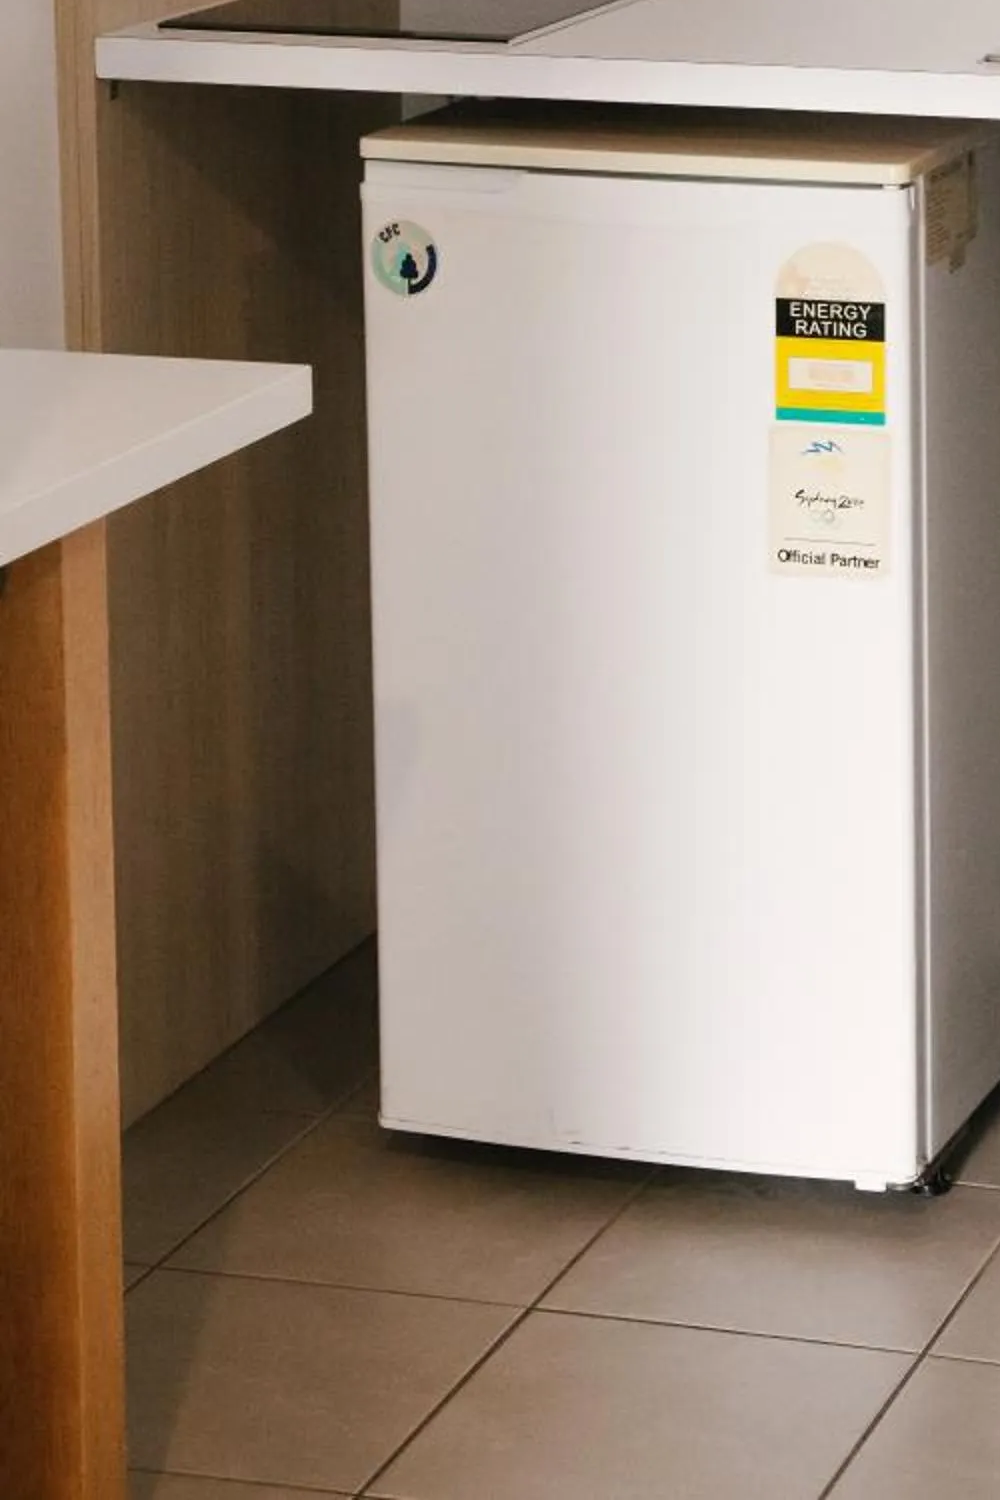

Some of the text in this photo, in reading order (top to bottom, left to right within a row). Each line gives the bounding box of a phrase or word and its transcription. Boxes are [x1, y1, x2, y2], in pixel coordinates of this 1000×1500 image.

[789, 301, 871, 320] ENERGY
[795, 319, 868, 338] RATING
[795, 489, 837, 508] Sydney
[777, 549, 880, 568] Official Partner
